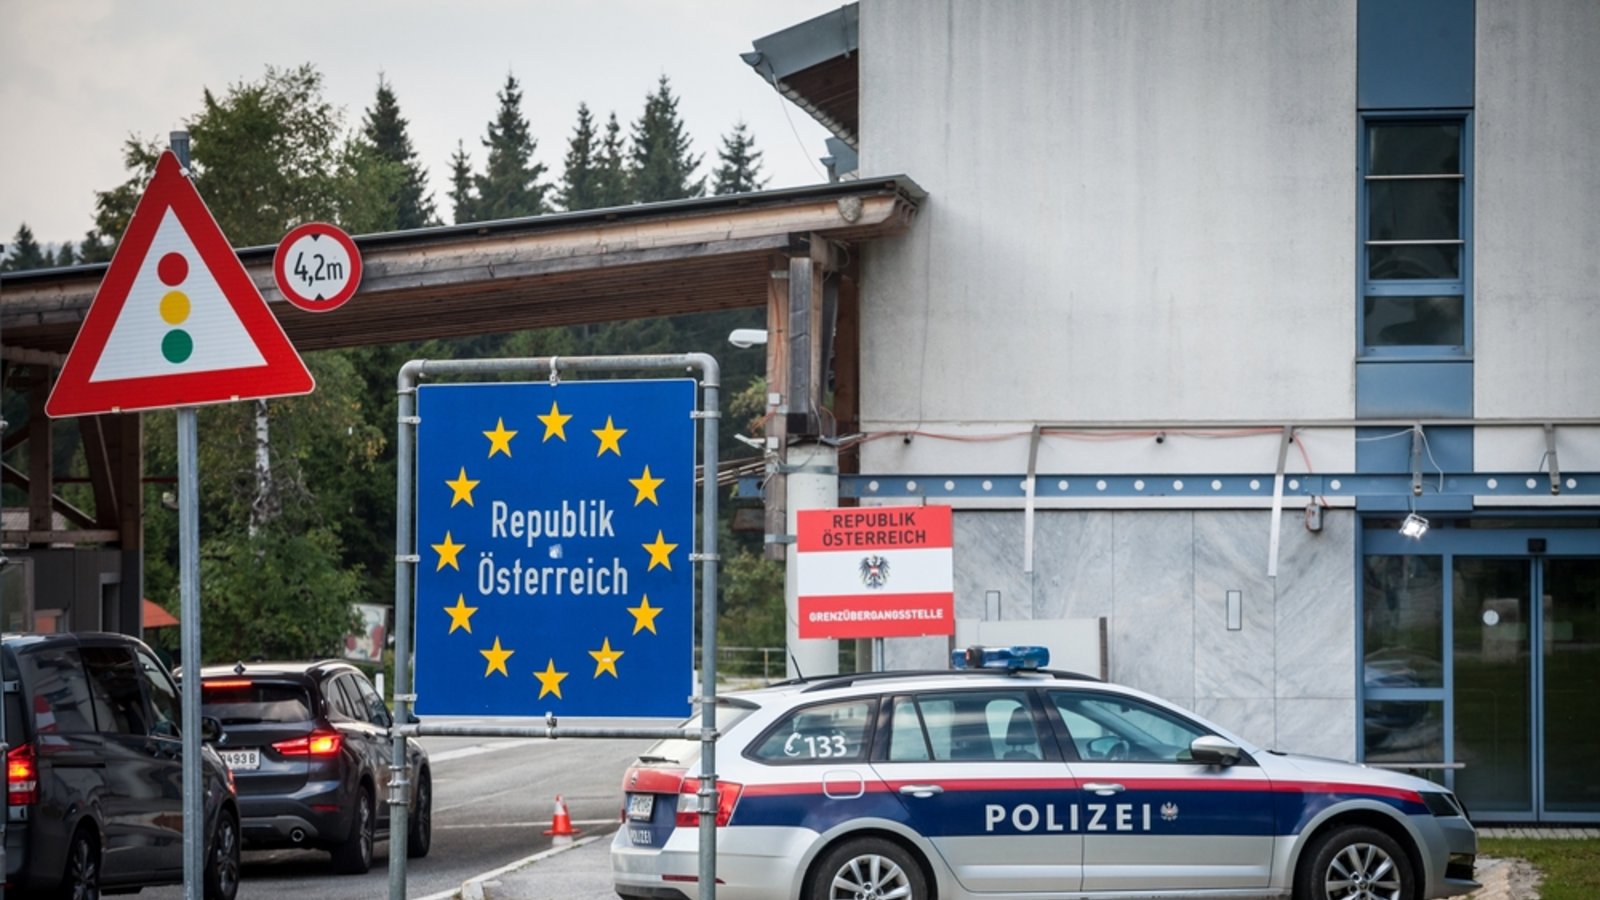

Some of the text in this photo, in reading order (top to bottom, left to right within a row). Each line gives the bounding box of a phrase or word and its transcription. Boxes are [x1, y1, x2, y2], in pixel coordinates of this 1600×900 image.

[294, 251, 343, 287] 4,2m
[492, 500, 615, 548] Republik
[832, 512, 916, 528] REPUBLIK
[822, 529, 926, 547] ÖSTERREICH
[478, 551, 628, 595] Österreich
[809, 608, 944, 622] GRENZÜBERGANGSSTELLE
[804, 735, 847, 758] 133
[985, 804, 1151, 831] POLIZEI
